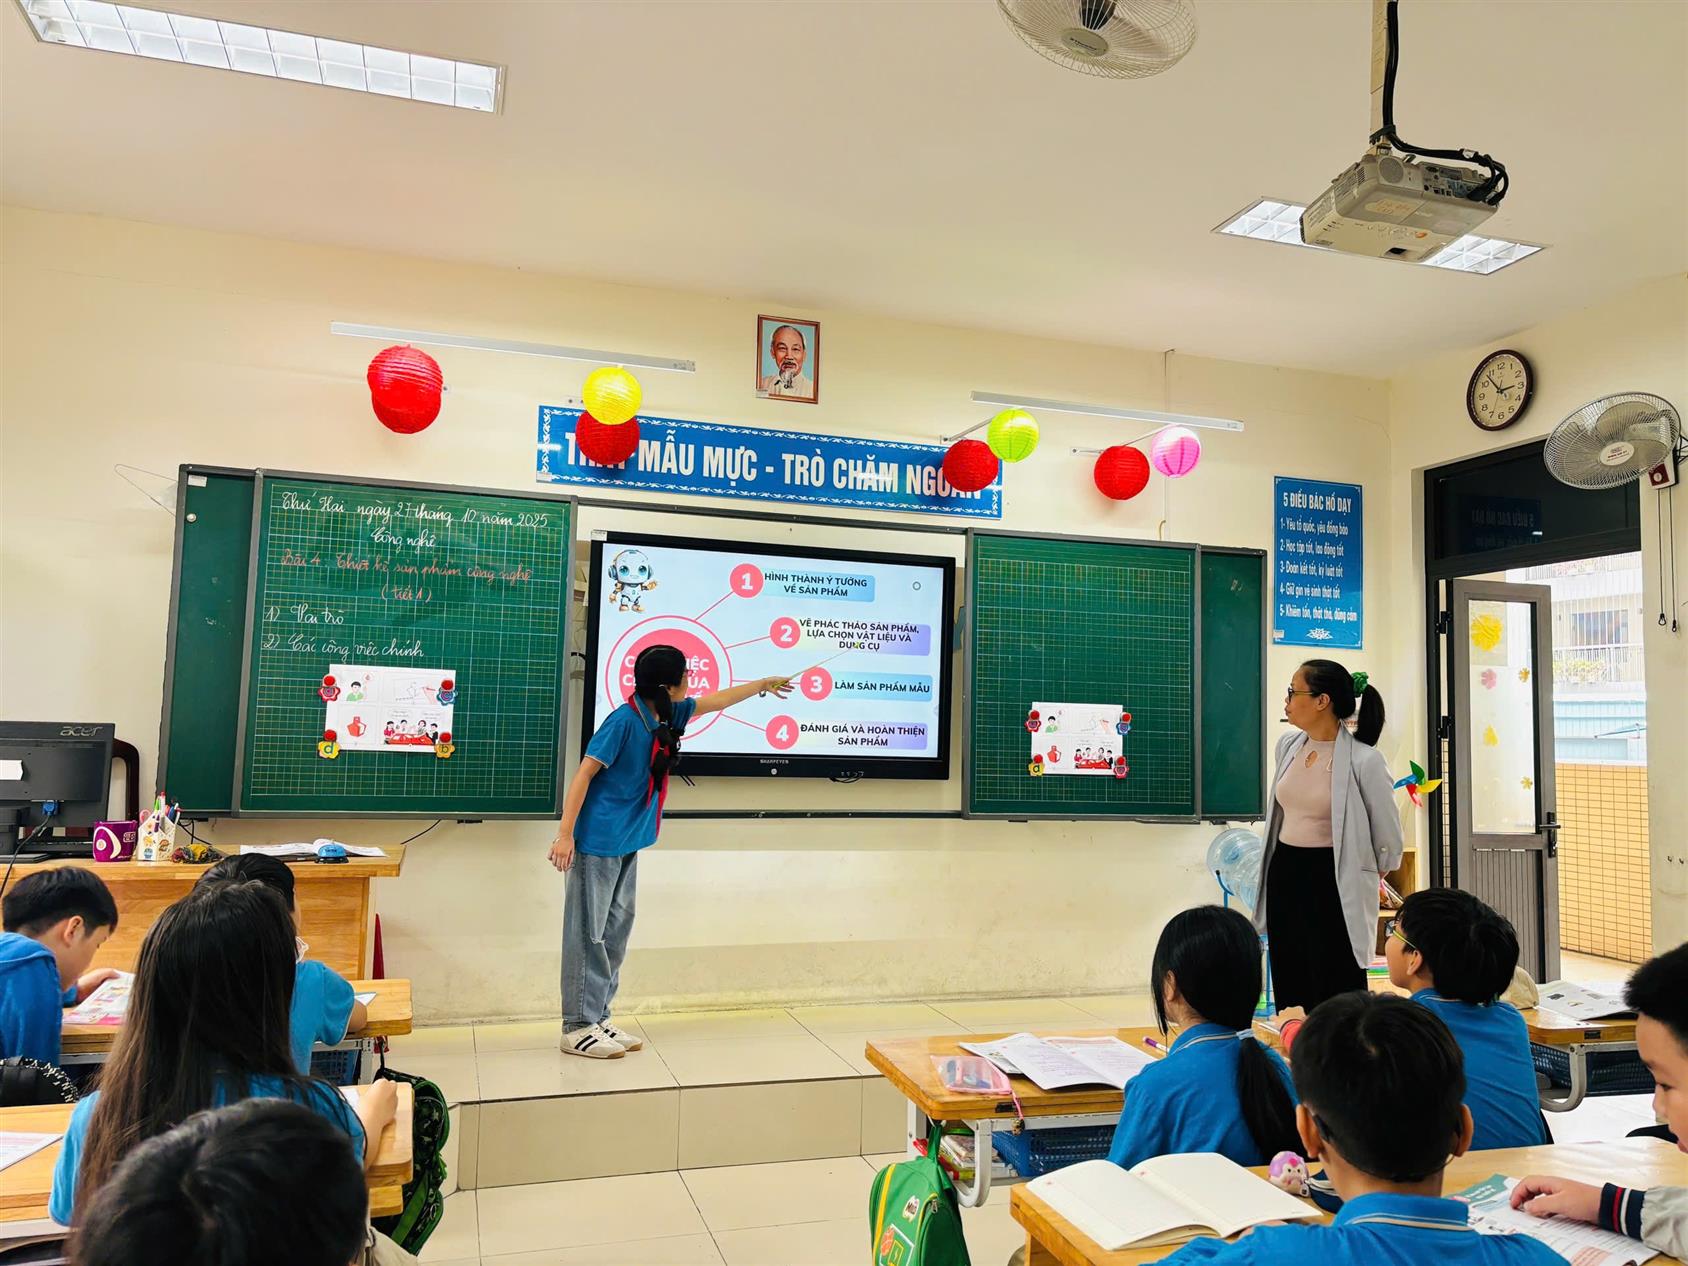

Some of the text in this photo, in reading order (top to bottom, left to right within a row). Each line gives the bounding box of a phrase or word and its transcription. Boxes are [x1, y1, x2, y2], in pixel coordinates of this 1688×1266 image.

[638, 429, 694, 476] MẪU
[703, 446, 758, 486] MỰC
[782, 448, 825, 487] TRÒ
[833, 454, 898, 493] CHĂM
[1284, 492, 1288, 506] 5
[1290, 488, 1307, 508] ĐIỀU
[1309, 492, 1324, 510] BÁC
[1338, 498, 1352, 516] DẠY
[319, 496, 344, 512] Hai
[358, 500, 390, 525] ngày
[463, 508, 476, 522] 10
[482, 512, 513, 526] năm
[516, 513, 548, 528] 2025
[741, 573, 754, 590] 1
[764, 572, 868, 587] HÌNH THÀNH Ý TƯỞNG
[780, 624, 792, 642] 2
[814, 619, 840, 628] PHÁC
[842, 620, 868, 630] THẢO
[870, 622, 888, 632] SẢN
[807, 629, 912, 643] LỰA CHỌN VẬT LIỆU VÀ
[868, 642, 880, 652] CỤ
[810, 676, 822, 693] 3
[834, 680, 854, 690] LÀM
[858, 681, 876, 690] SẢN
[880, 680, 906, 692] PHẨM
[60, 726, 103, 737] acer
[776, 724, 789, 742] 4
[800, 724, 925, 738] ĐÁNH GIÁ VÀ HOÀN THIỆN
[838, 736, 888, 746] SẢN PHẨM
